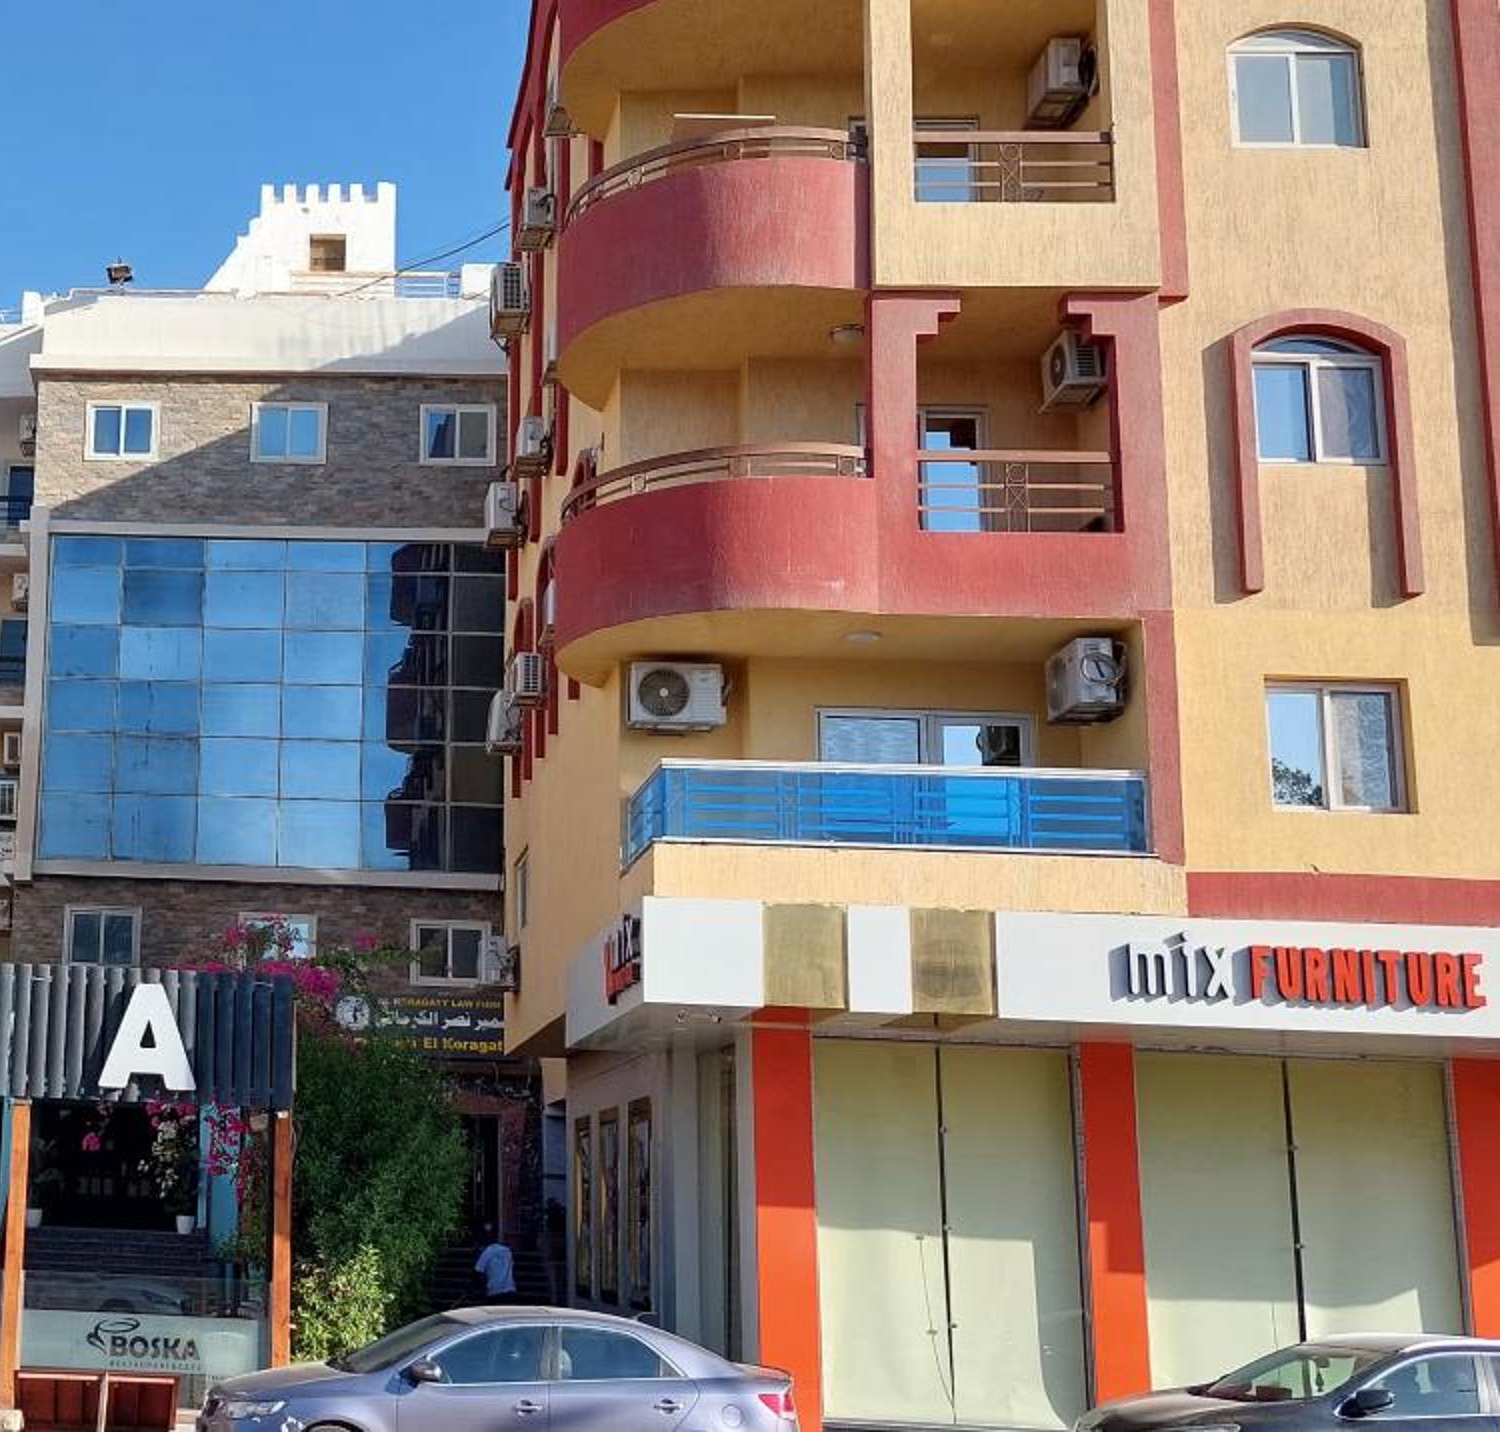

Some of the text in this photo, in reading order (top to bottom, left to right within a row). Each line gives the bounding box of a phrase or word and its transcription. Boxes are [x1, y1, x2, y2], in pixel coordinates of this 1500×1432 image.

[1108, 932, 1487, 1007] mix FURNITURE
[423, 1037, 437, 1049] El
[109, 1335, 200, 1361] BOSKA
